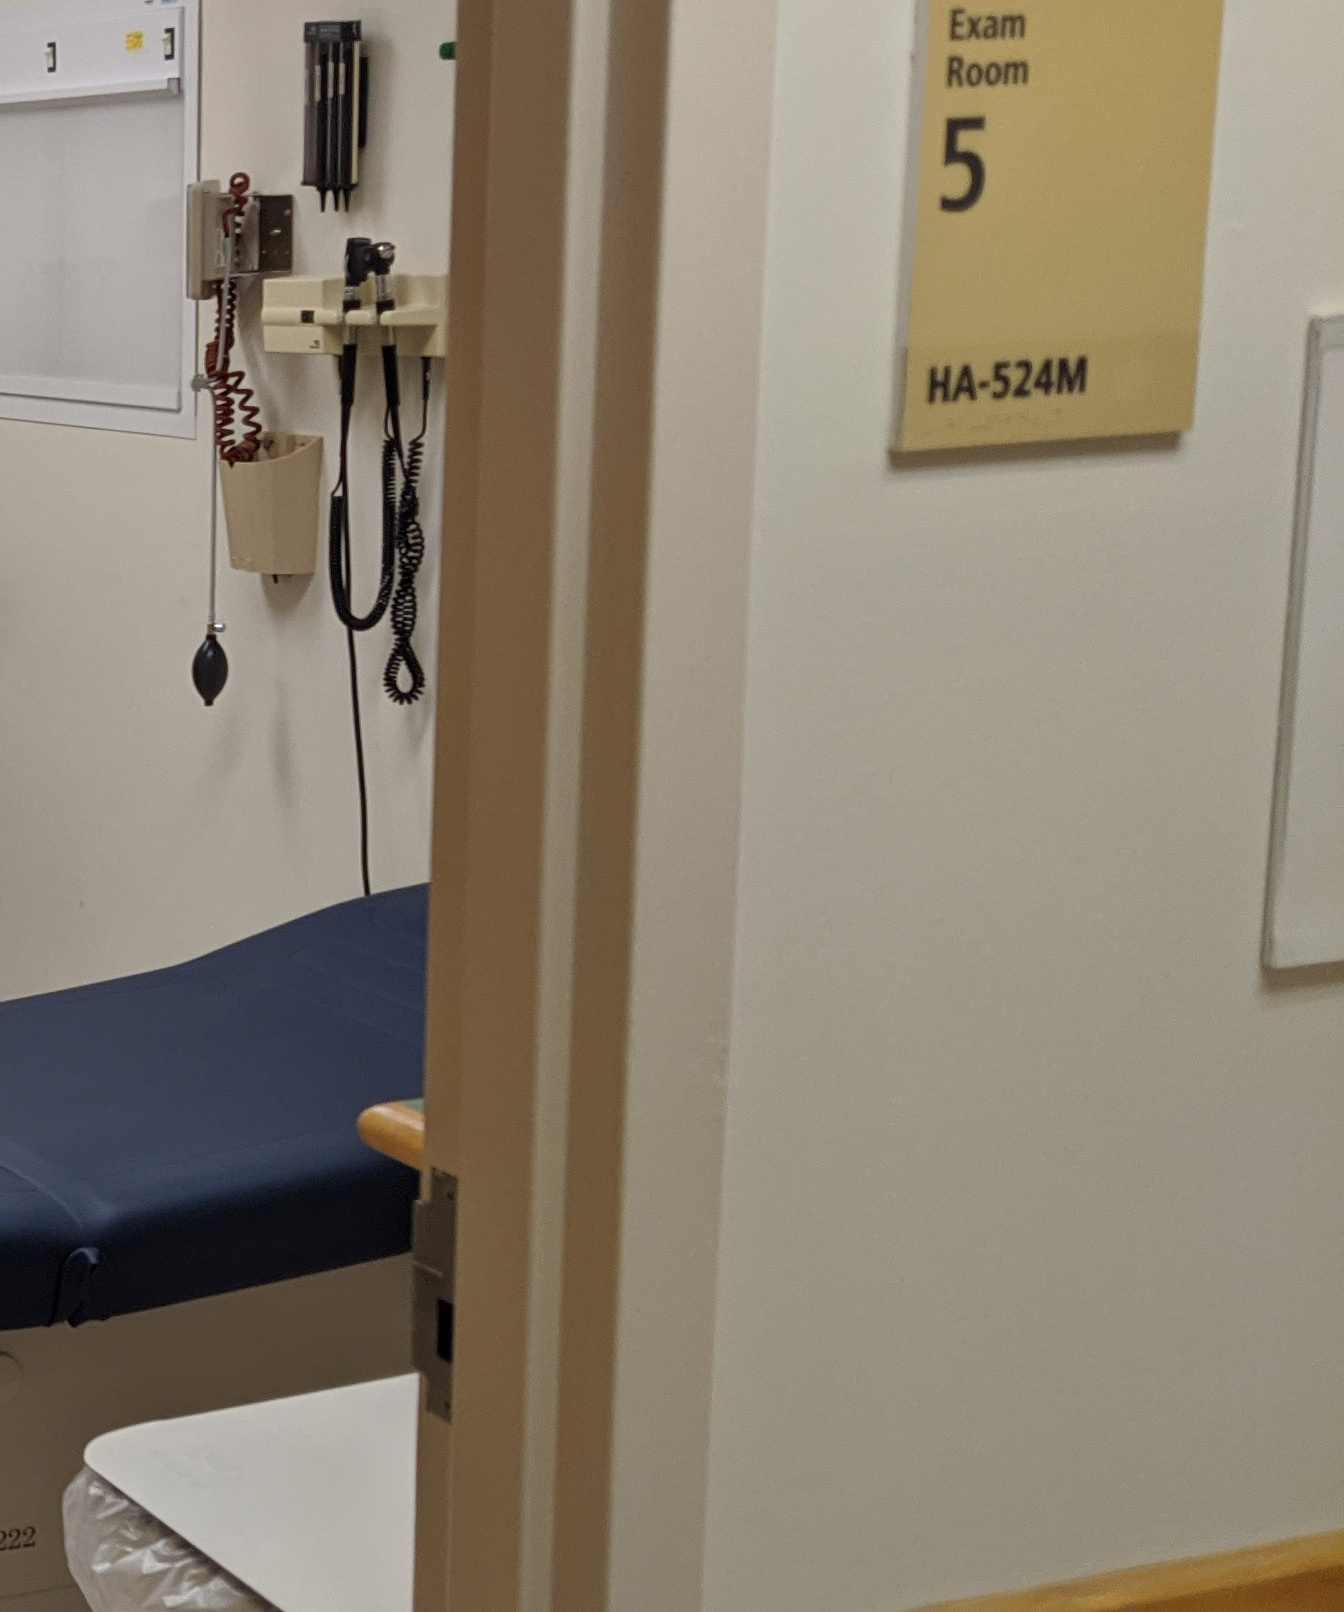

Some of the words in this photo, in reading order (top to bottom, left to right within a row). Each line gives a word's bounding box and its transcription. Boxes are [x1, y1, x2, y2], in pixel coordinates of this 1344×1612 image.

[949, 8, 1026, 41] Exam
[946, 55, 1030, 88] Room
[939, 116, 986, 213] 5
[927, 355, 1088, 404] HA-524M
